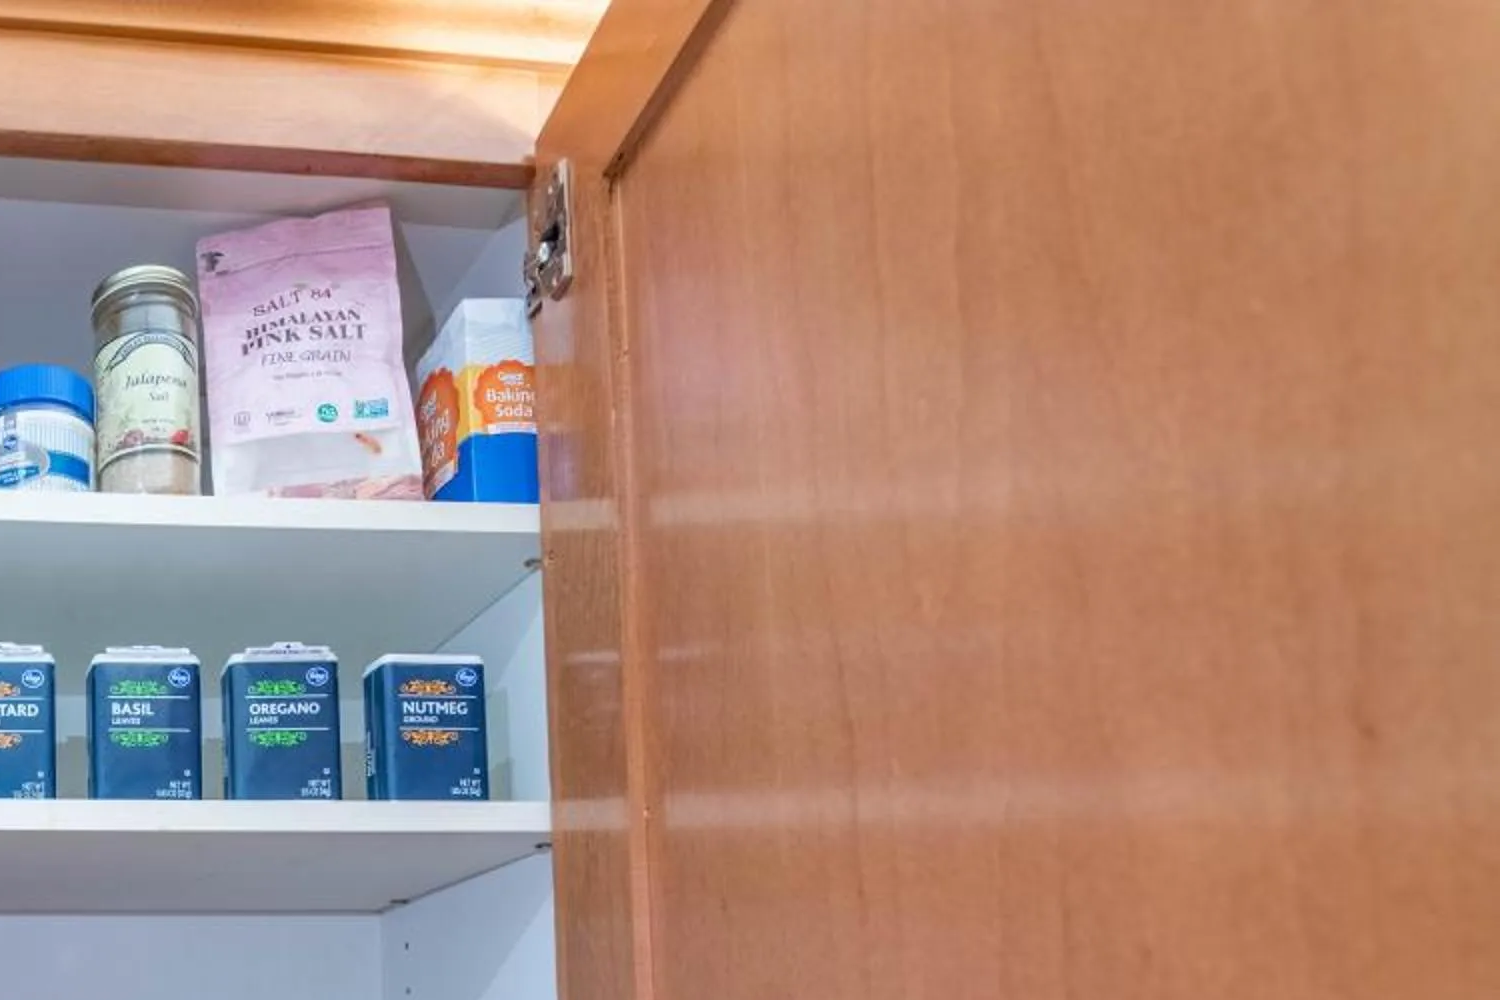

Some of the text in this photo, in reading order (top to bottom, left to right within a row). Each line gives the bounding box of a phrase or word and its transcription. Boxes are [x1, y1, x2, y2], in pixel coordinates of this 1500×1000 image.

[252, 289, 301, 317] SALT
[245, 308, 362, 341] HIMALAYAN
[241, 322, 368, 357] PINK SALT
[261, 349, 352, 369] FINE GRAIN
[495, 406, 533, 419] Soda
[111, 702, 155, 716] BASIL
[249, 701, 321, 716] OREGANO
[402, 701, 468, 715] NUTMEG
